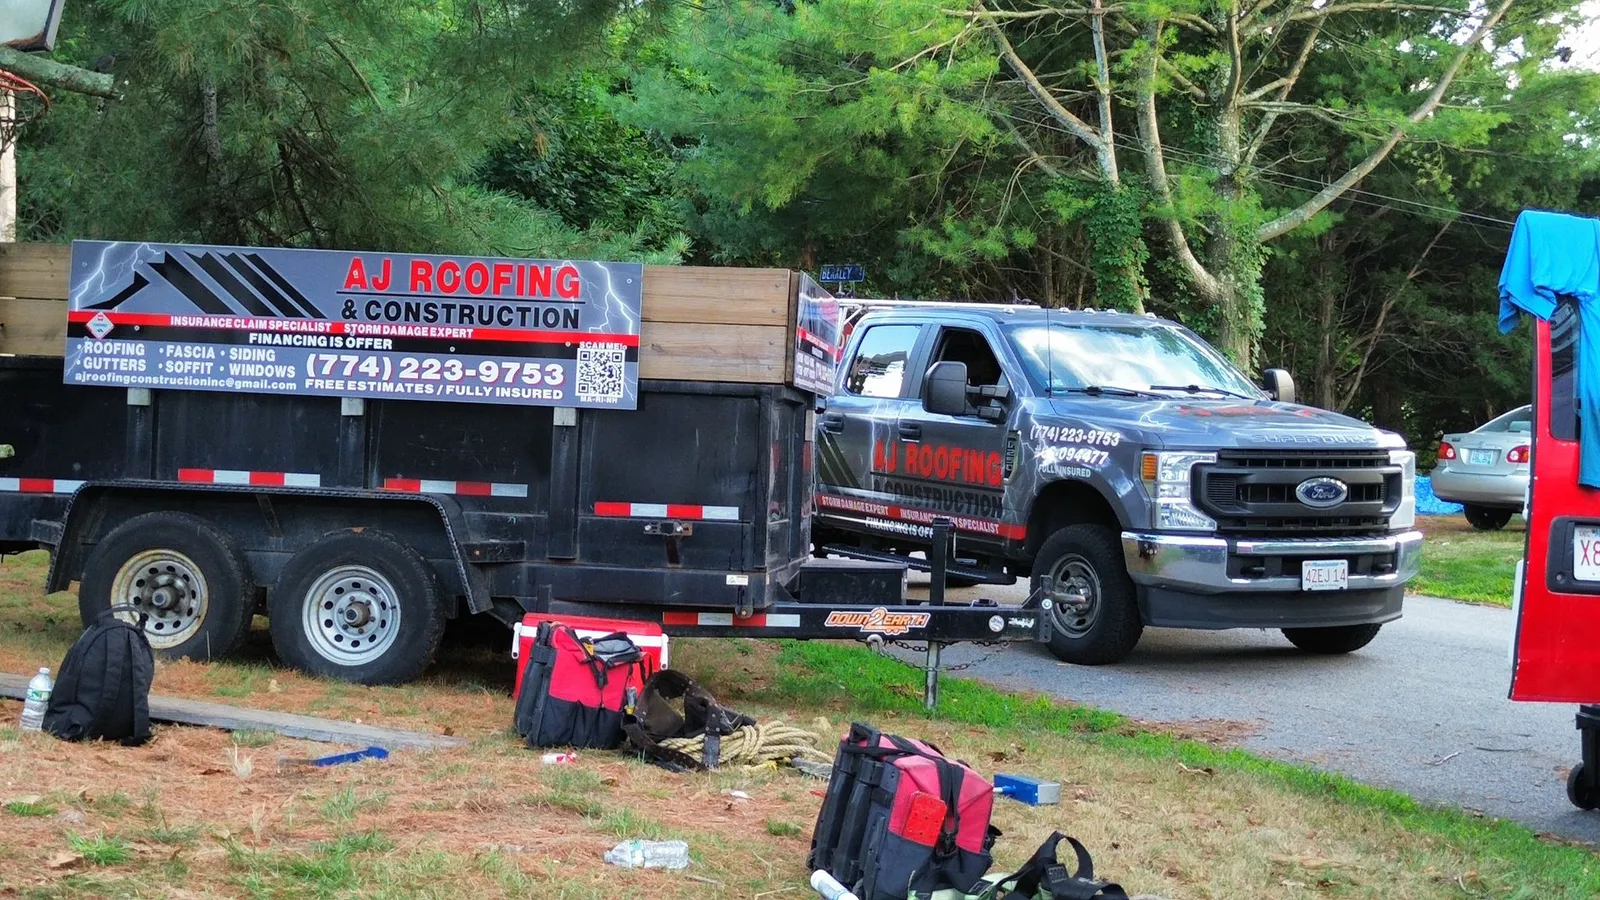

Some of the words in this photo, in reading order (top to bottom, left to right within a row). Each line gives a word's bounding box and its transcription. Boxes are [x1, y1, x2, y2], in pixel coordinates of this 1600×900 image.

[344, 257, 392, 291] AJ
[410, 260, 580, 299] ROOFING
[341, 299, 357, 320] &
[365, 300, 580, 329] CONSTRUCTION
[170, 316, 232, 328] INSURANCE
[233, 317, 268, 330] CLAIM
[268, 319, 332, 332] SPECIALIST
[344, 324, 381, 335] STORM
[381, 325, 430, 337] DAMAGE
[430, 327, 473, 339] EXPERT
[84, 341, 145, 356] ROOFING
[249, 333, 328, 348] FINANCING
[329, 336, 344, 348] IS
[345, 337, 393, 350] OFFER
[166, 345, 216, 359] FASCIA
[229, 347, 276, 362] SIDING
[83, 357, 147, 372] GUTTERS
[165, 361, 213, 375] SOFFIT
[229, 363, 296, 378] WINDOWS
[306, 352, 392, 381] (774)
[399, 356, 564, 386] 223-9753
[75, 371, 297, 392] ajroofingconstructioninc@gmail.com
[305, 378, 345, 391] FREE
[347, 380, 434, 394] ESTIMATES
[446, 384, 493, 397] FULLY
[495, 387, 564, 400] INSURED
[1030, 425, 1059, 442] (774)
[1252, 434, 1319, 443] SUPER
[873, 440, 897, 473] AJ
[905, 443, 1003, 487] ROOFING
[1311, 485, 1336, 499] Ford
[822, 496, 840, 508] STORM
[841, 498, 865, 512] DAMAGE
[865, 503, 889, 516] EXPERT
[958, 517, 999, 535] SPECIALIST
